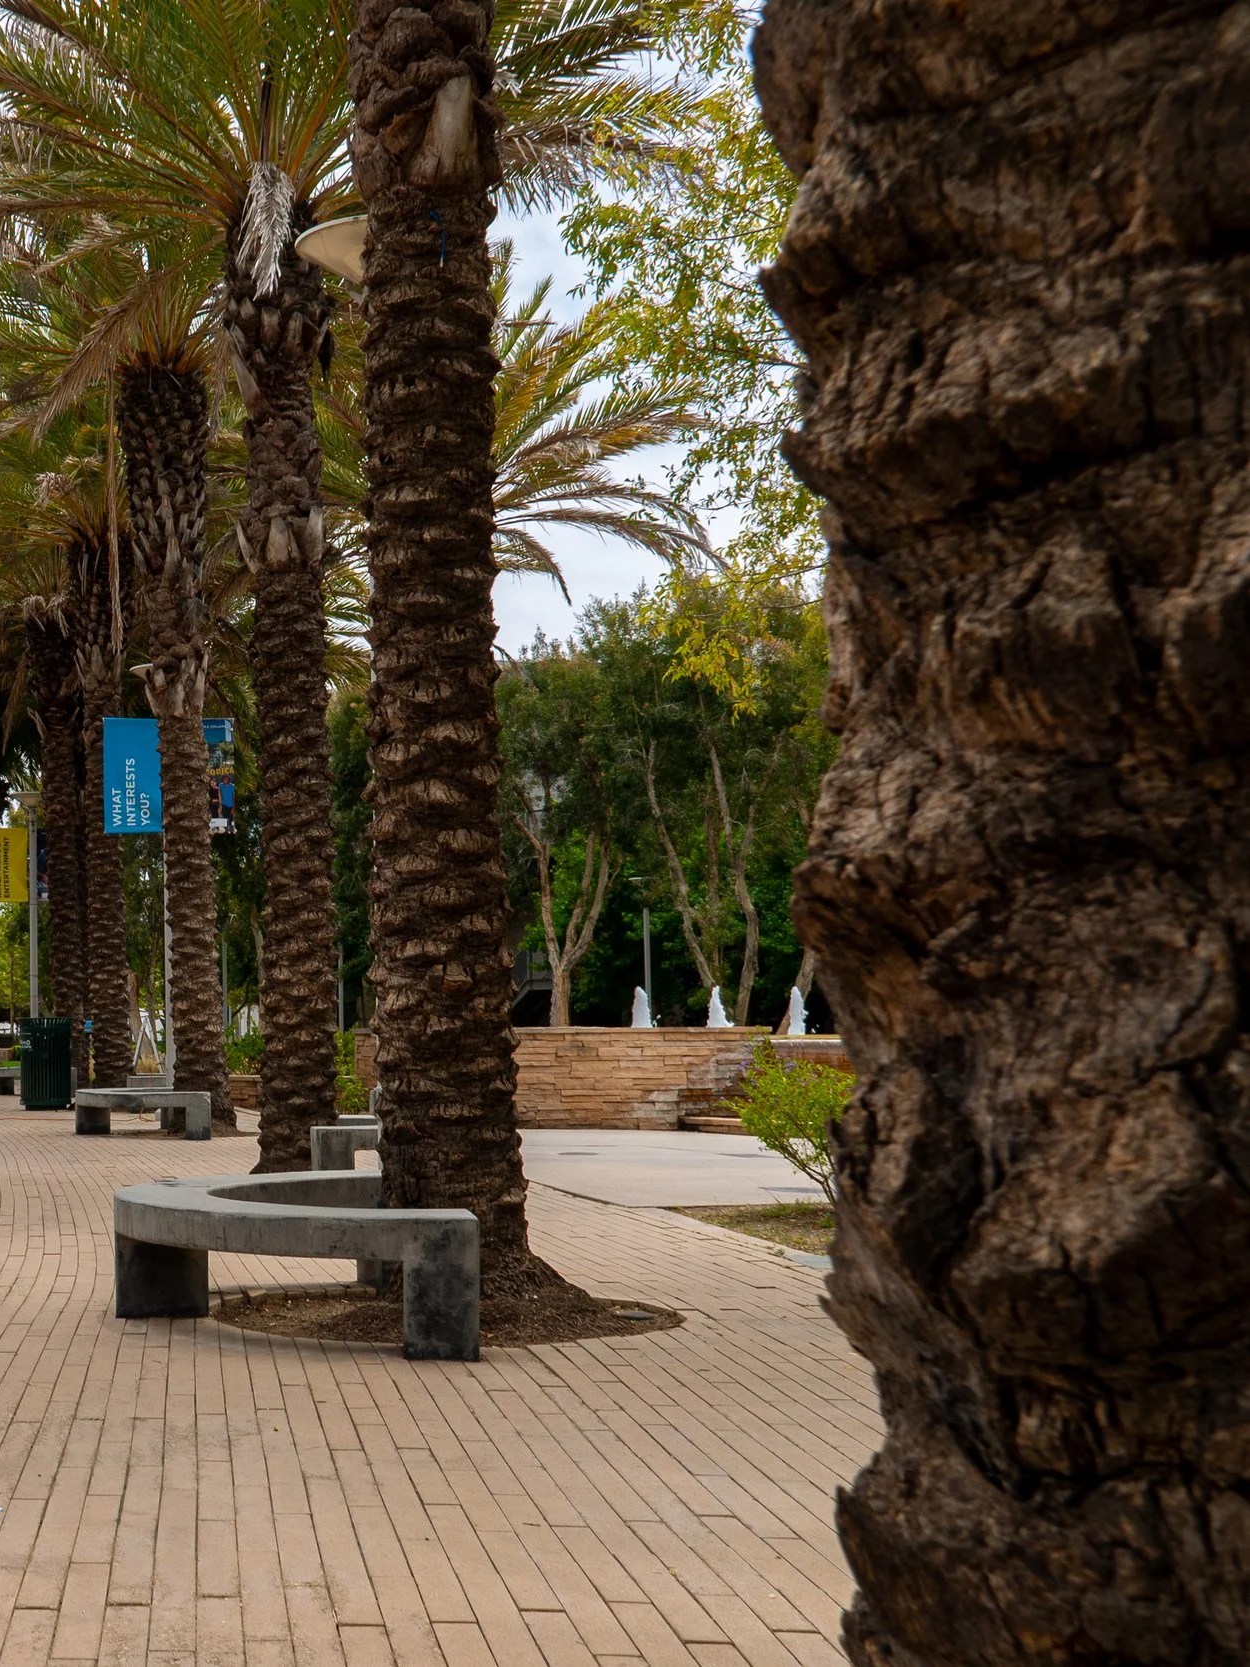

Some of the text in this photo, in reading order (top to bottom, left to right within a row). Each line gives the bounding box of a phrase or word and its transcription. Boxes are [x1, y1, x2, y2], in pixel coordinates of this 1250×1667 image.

[111, 788, 123, 827] WHAT
[125, 758, 137, 826] INTERESTS
[139, 793, 150, 826] YOU?
